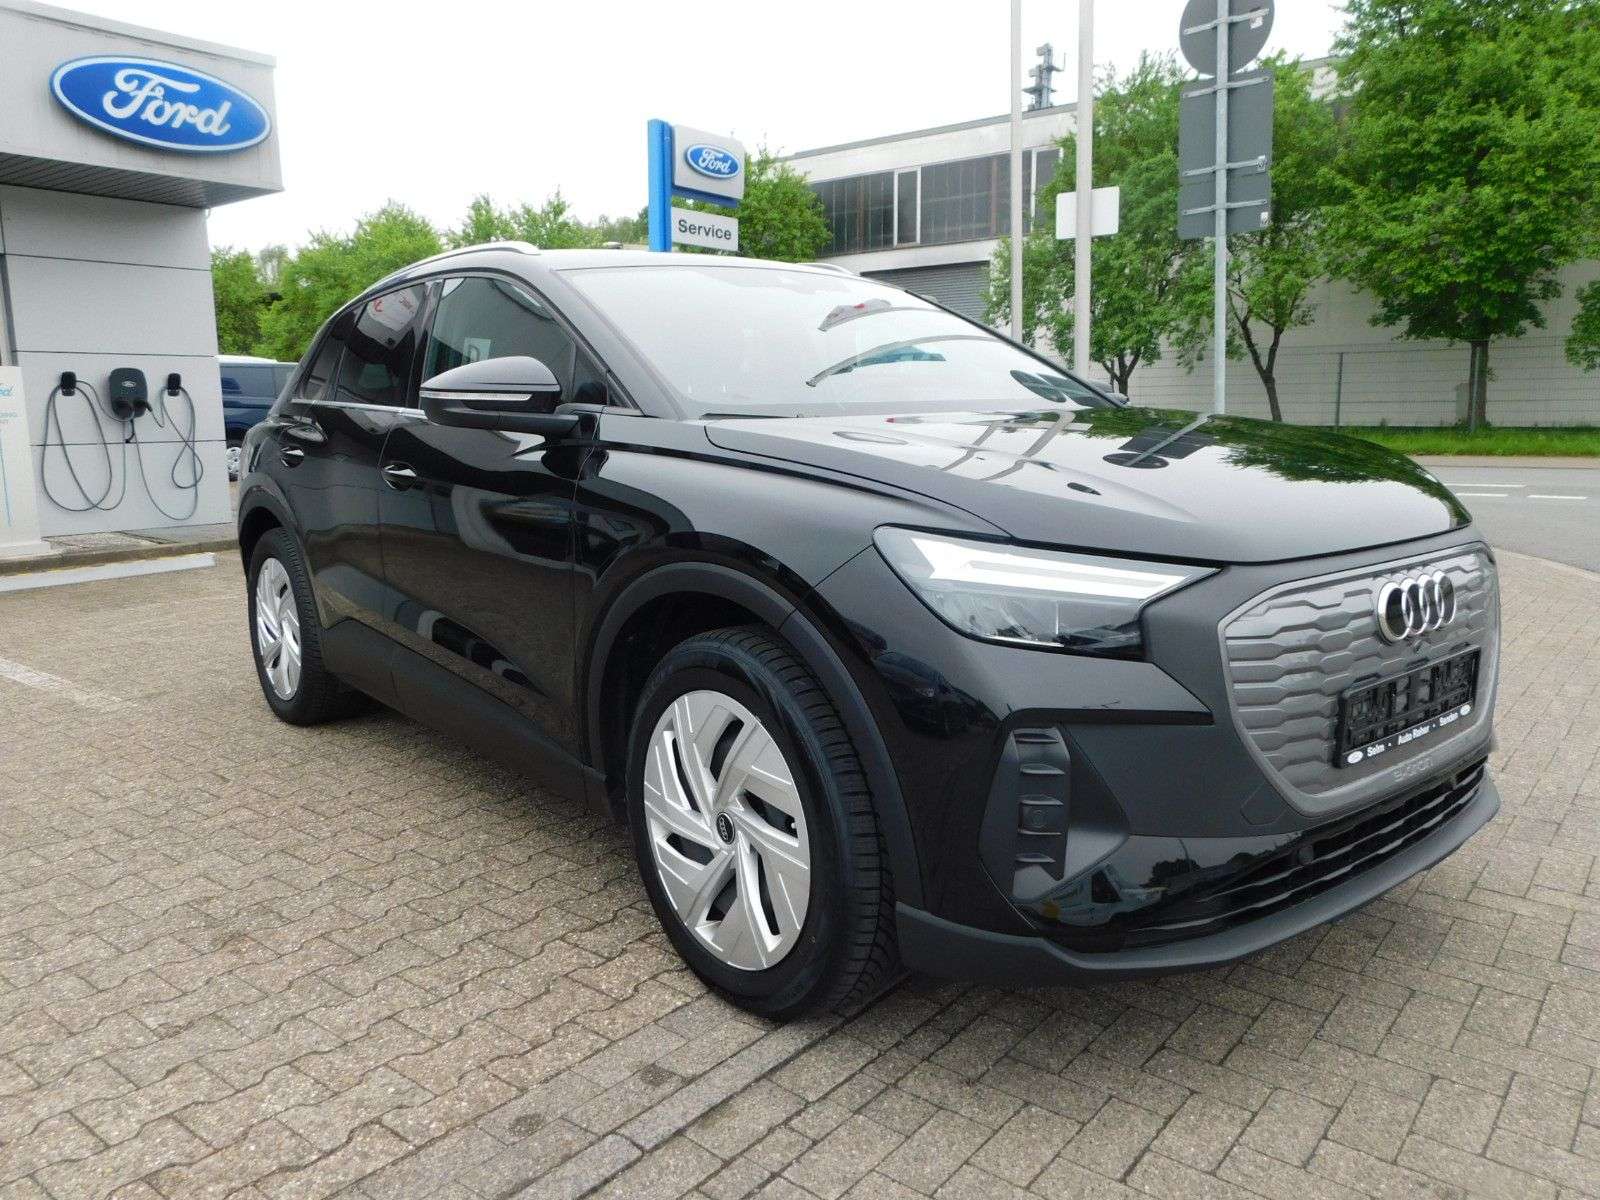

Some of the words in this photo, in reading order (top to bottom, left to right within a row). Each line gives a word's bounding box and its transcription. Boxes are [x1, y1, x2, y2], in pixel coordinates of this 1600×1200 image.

[102, 68, 231, 137] Ford
[698, 148, 732, 174] Ford
[678, 219, 732, 240] Service
